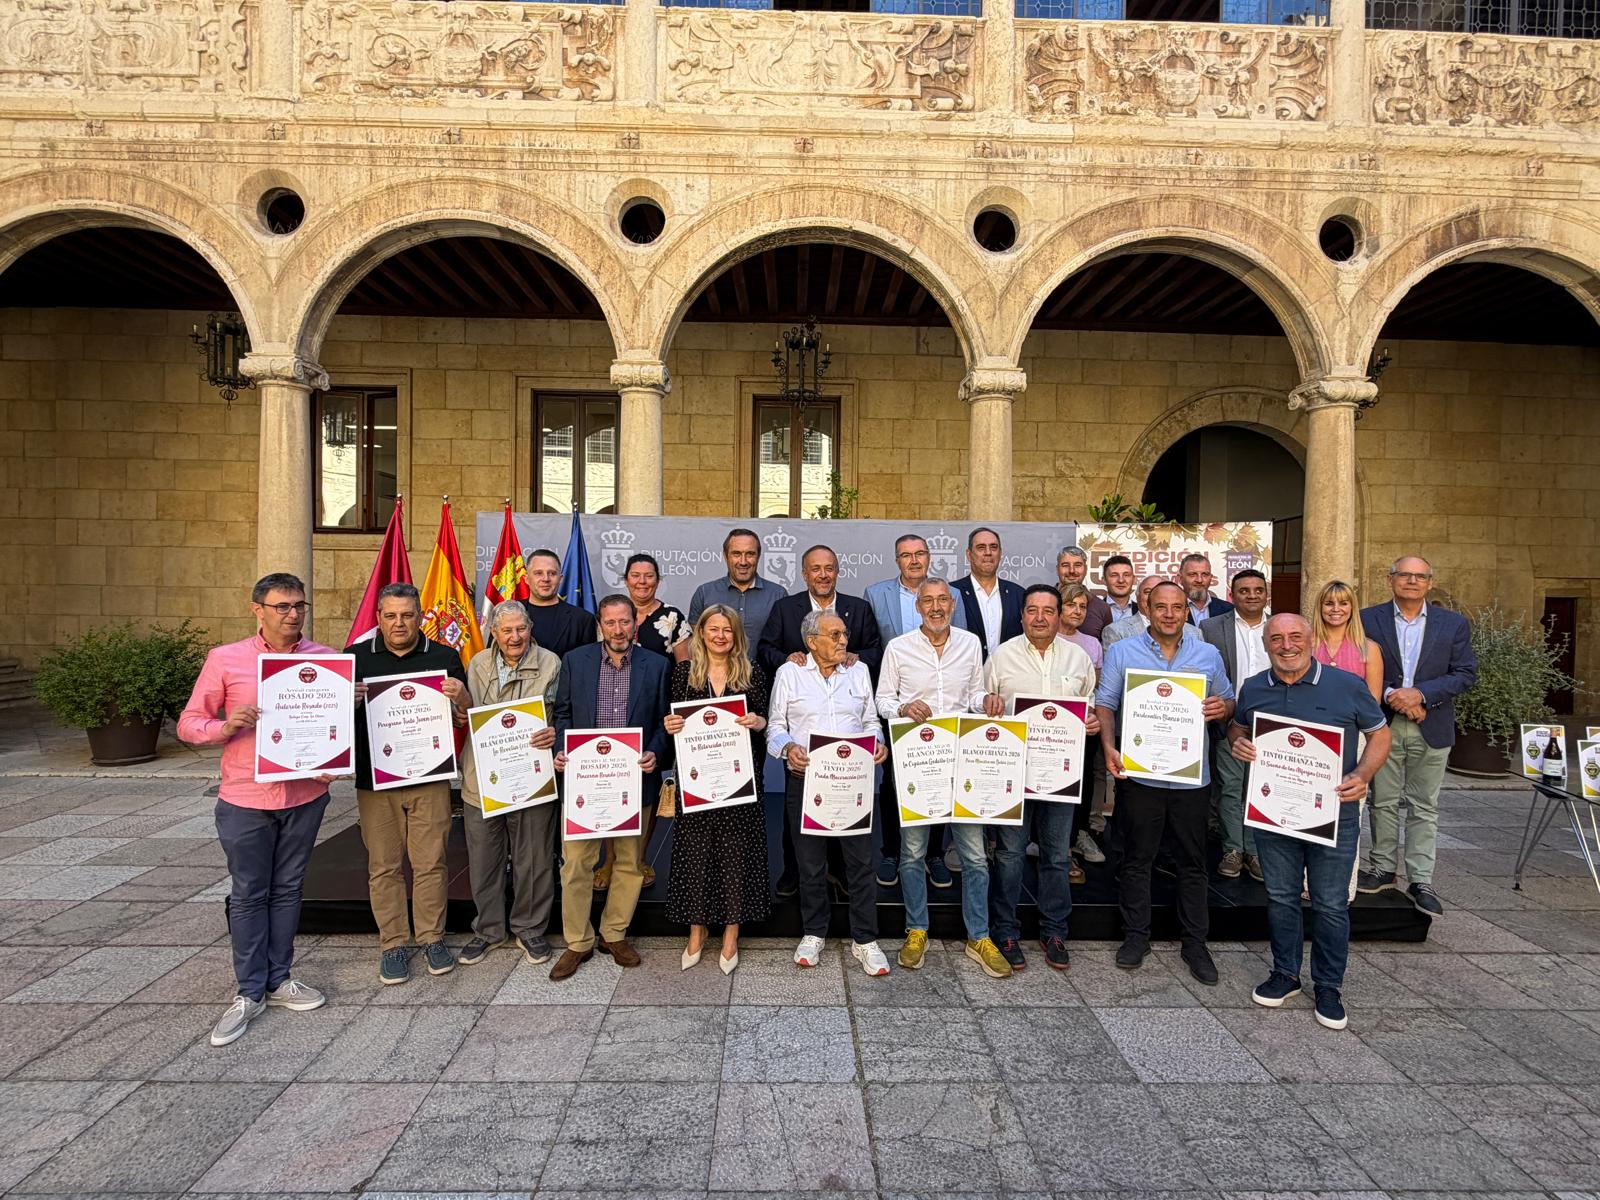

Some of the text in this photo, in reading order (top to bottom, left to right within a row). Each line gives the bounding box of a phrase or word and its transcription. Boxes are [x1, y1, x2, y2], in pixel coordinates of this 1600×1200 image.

[662, 563, 697, 576] LEÓN
[1228, 558, 1252, 569] LEÓN
[278, 692, 314, 700] ROSADO
[387, 705, 431, 717] TINTO 2026
[1139, 703, 1189, 714] BLANCO 2026
[480, 732, 529, 749] BLANCO CRIANZA
[684, 729, 740, 744] TINTO CRIANZA 2026
[907, 750, 935, 758] BLANCO
[1262, 750, 1331, 770] TINTO CRIANZA 2026
